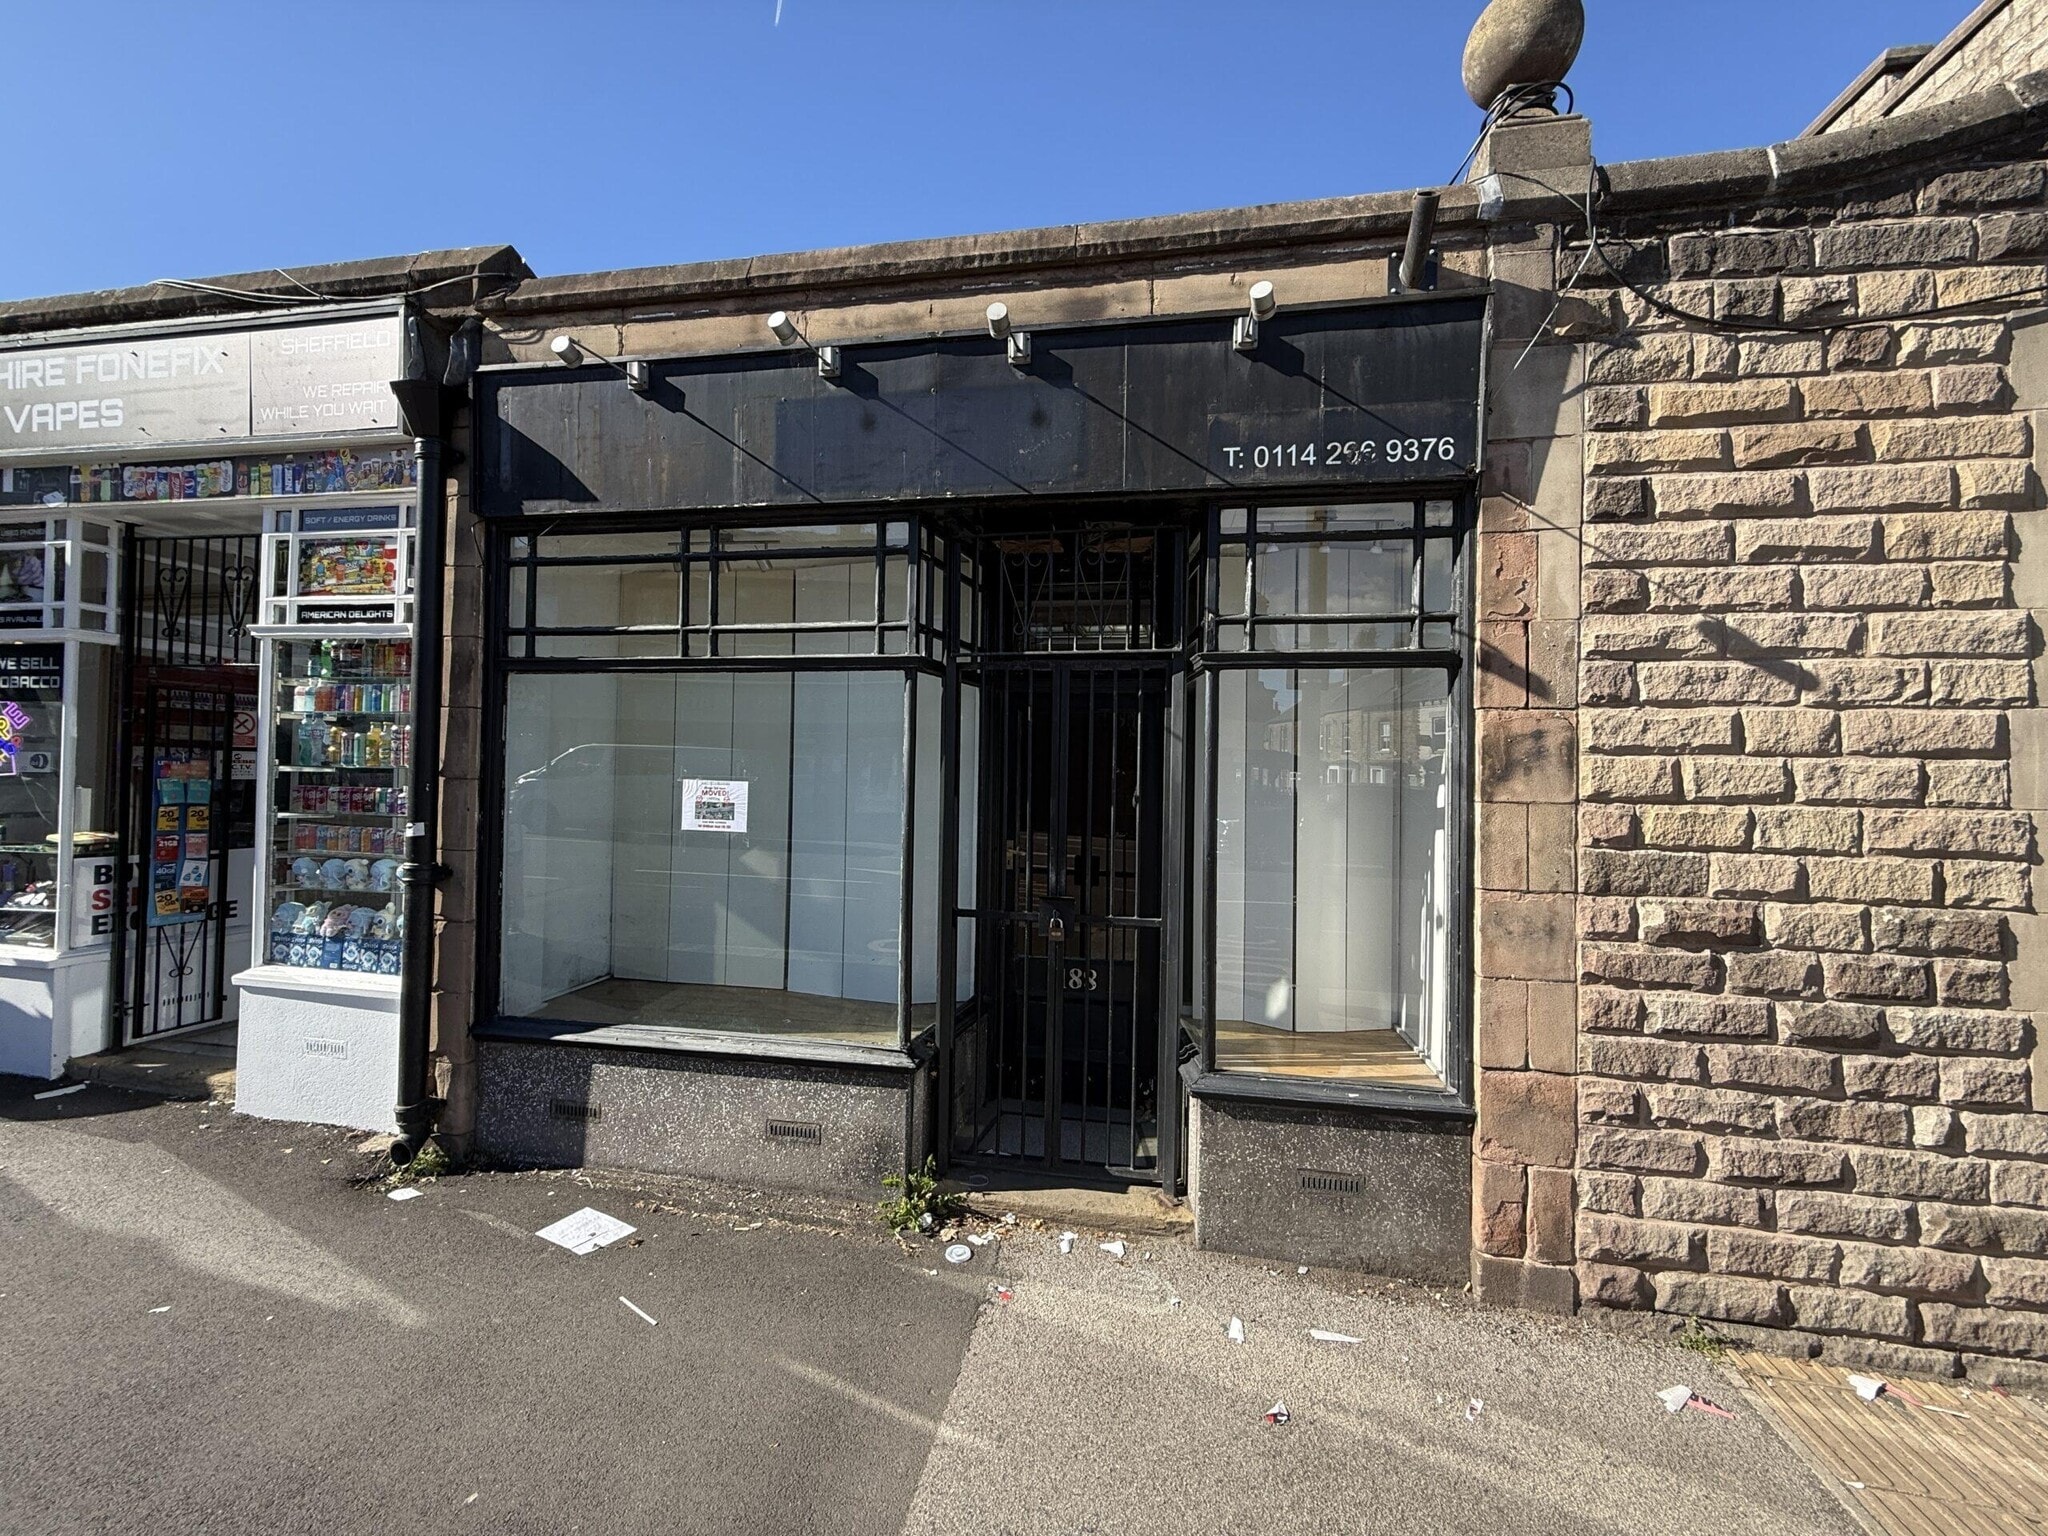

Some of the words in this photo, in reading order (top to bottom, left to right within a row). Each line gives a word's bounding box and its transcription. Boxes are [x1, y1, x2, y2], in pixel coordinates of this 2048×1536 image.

[280, 330, 392, 355] SHEFFIELD
[76, 346, 224, 385] FONEFIX
[302, 384, 328, 398] WE
[331, 380, 388, 397] REPAIR
[4, 398, 124, 434] VAPES
[260, 405, 309, 421] WHILE
[312, 402, 345, 417] YOU
[348, 399, 388, 414] WAIT
[1222, 446, 1244, 469] T:
[1253, 442, 1317, 468] 0114
[1385, 436, 1455, 463] 9376
[305, 516, 326, 525] SOFT
[333, 514, 366, 523] ENERGY
[366, 513, 397, 522] DRINKS
[301, 610, 347, 620] AMERICAN
[348, 609, 394, 619] DELIGHTS
[20, 656, 60, 670] SELL
